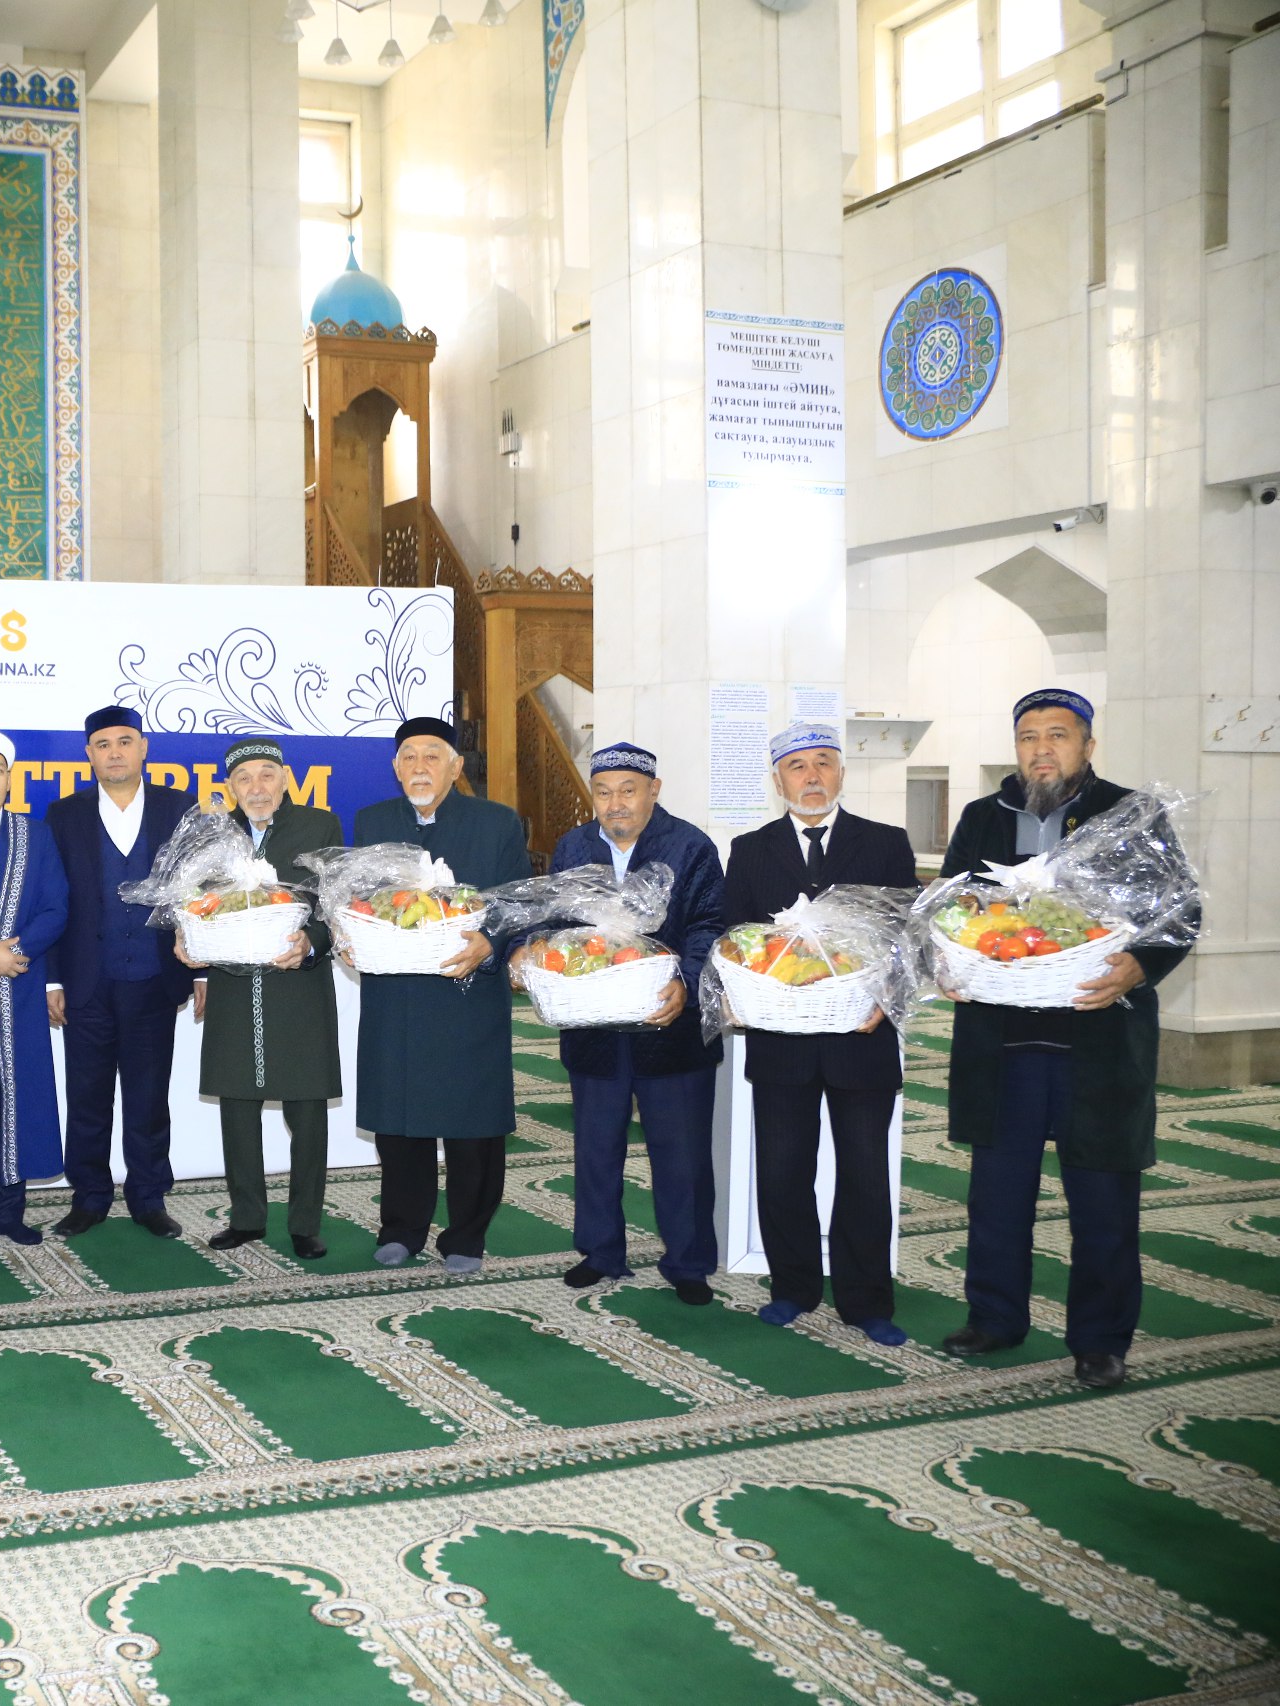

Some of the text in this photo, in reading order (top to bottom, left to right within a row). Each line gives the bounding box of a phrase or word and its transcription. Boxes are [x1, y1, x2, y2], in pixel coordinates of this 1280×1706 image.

[730, 331, 820, 347] МЕШІТКЕ КЕЛУШІ
[716, 378, 779, 392] намаздағы
[763, 398, 796, 410] іштей
[762, 417, 843, 431] тыныштығын
